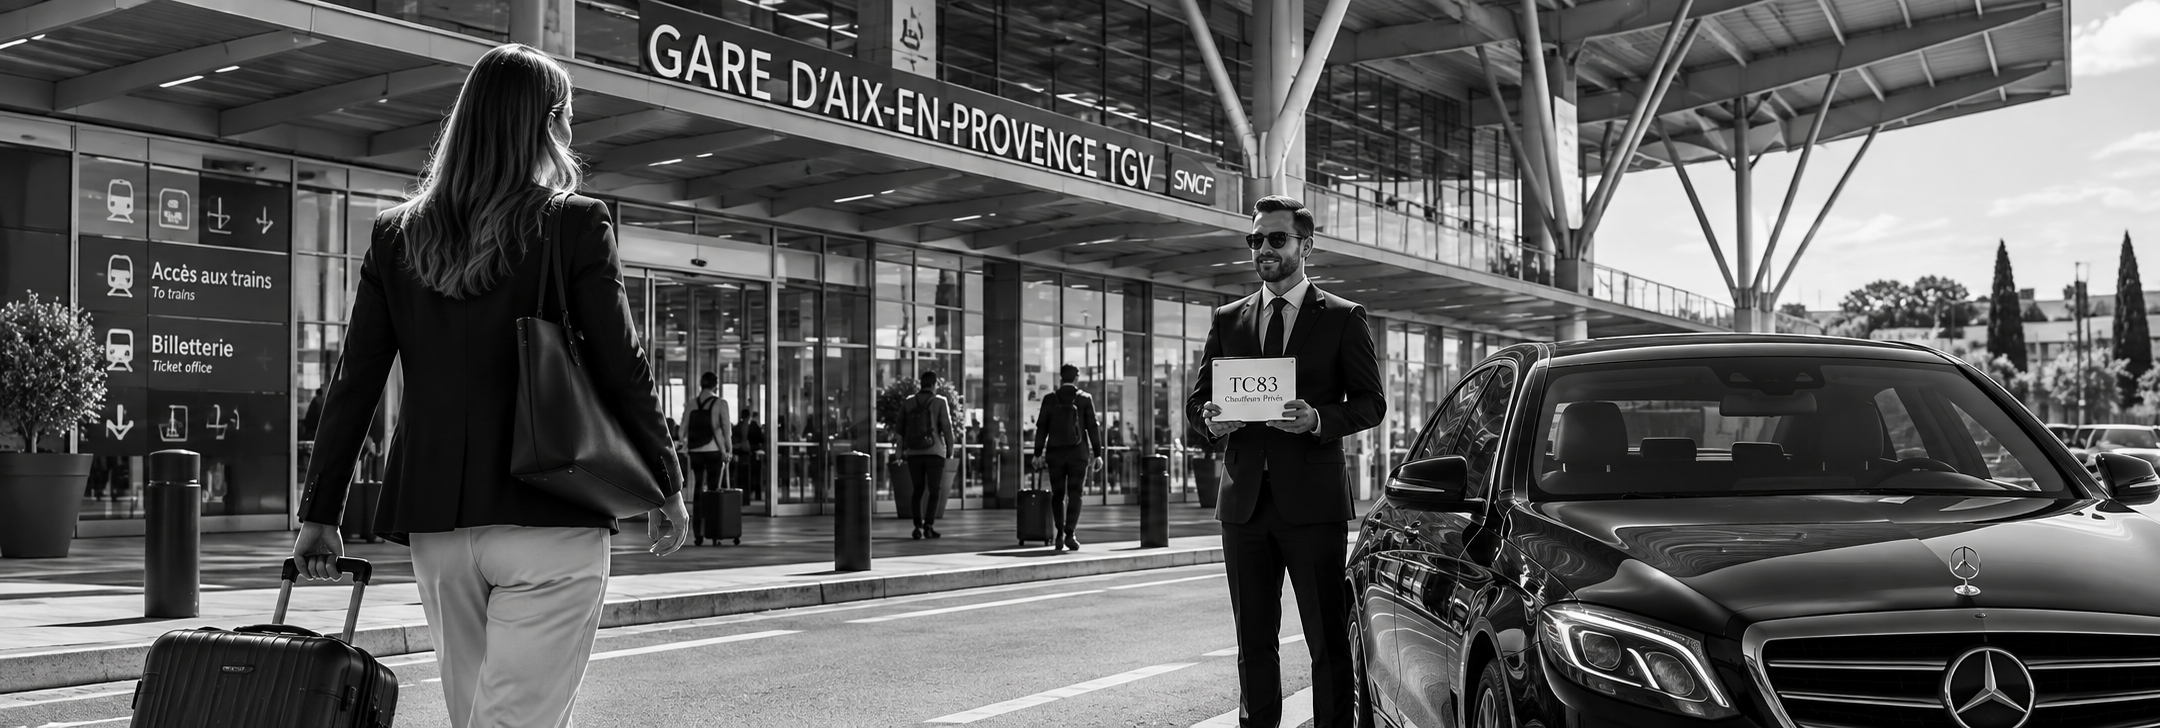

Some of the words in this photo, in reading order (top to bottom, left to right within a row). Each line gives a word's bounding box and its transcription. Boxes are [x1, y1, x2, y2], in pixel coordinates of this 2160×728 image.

[649, 25, 770, 98] GARE
[790, 60, 1097, 177] D'AIX-EN-PROVENCE
[1105, 142, 1154, 190] TGV
[1173, 169, 1214, 196] SNCF
[151, 261, 197, 283] Accès
[201, 270, 228, 285] aux
[230, 270, 272, 289] trains
[152, 286, 165, 299] To
[168, 288, 195, 301] trains
[152, 334, 234, 358] Billetterie
[152, 359, 182, 373] Ticket
[185, 361, 213, 374] office
[1229, 376, 1278, 393] TC83
